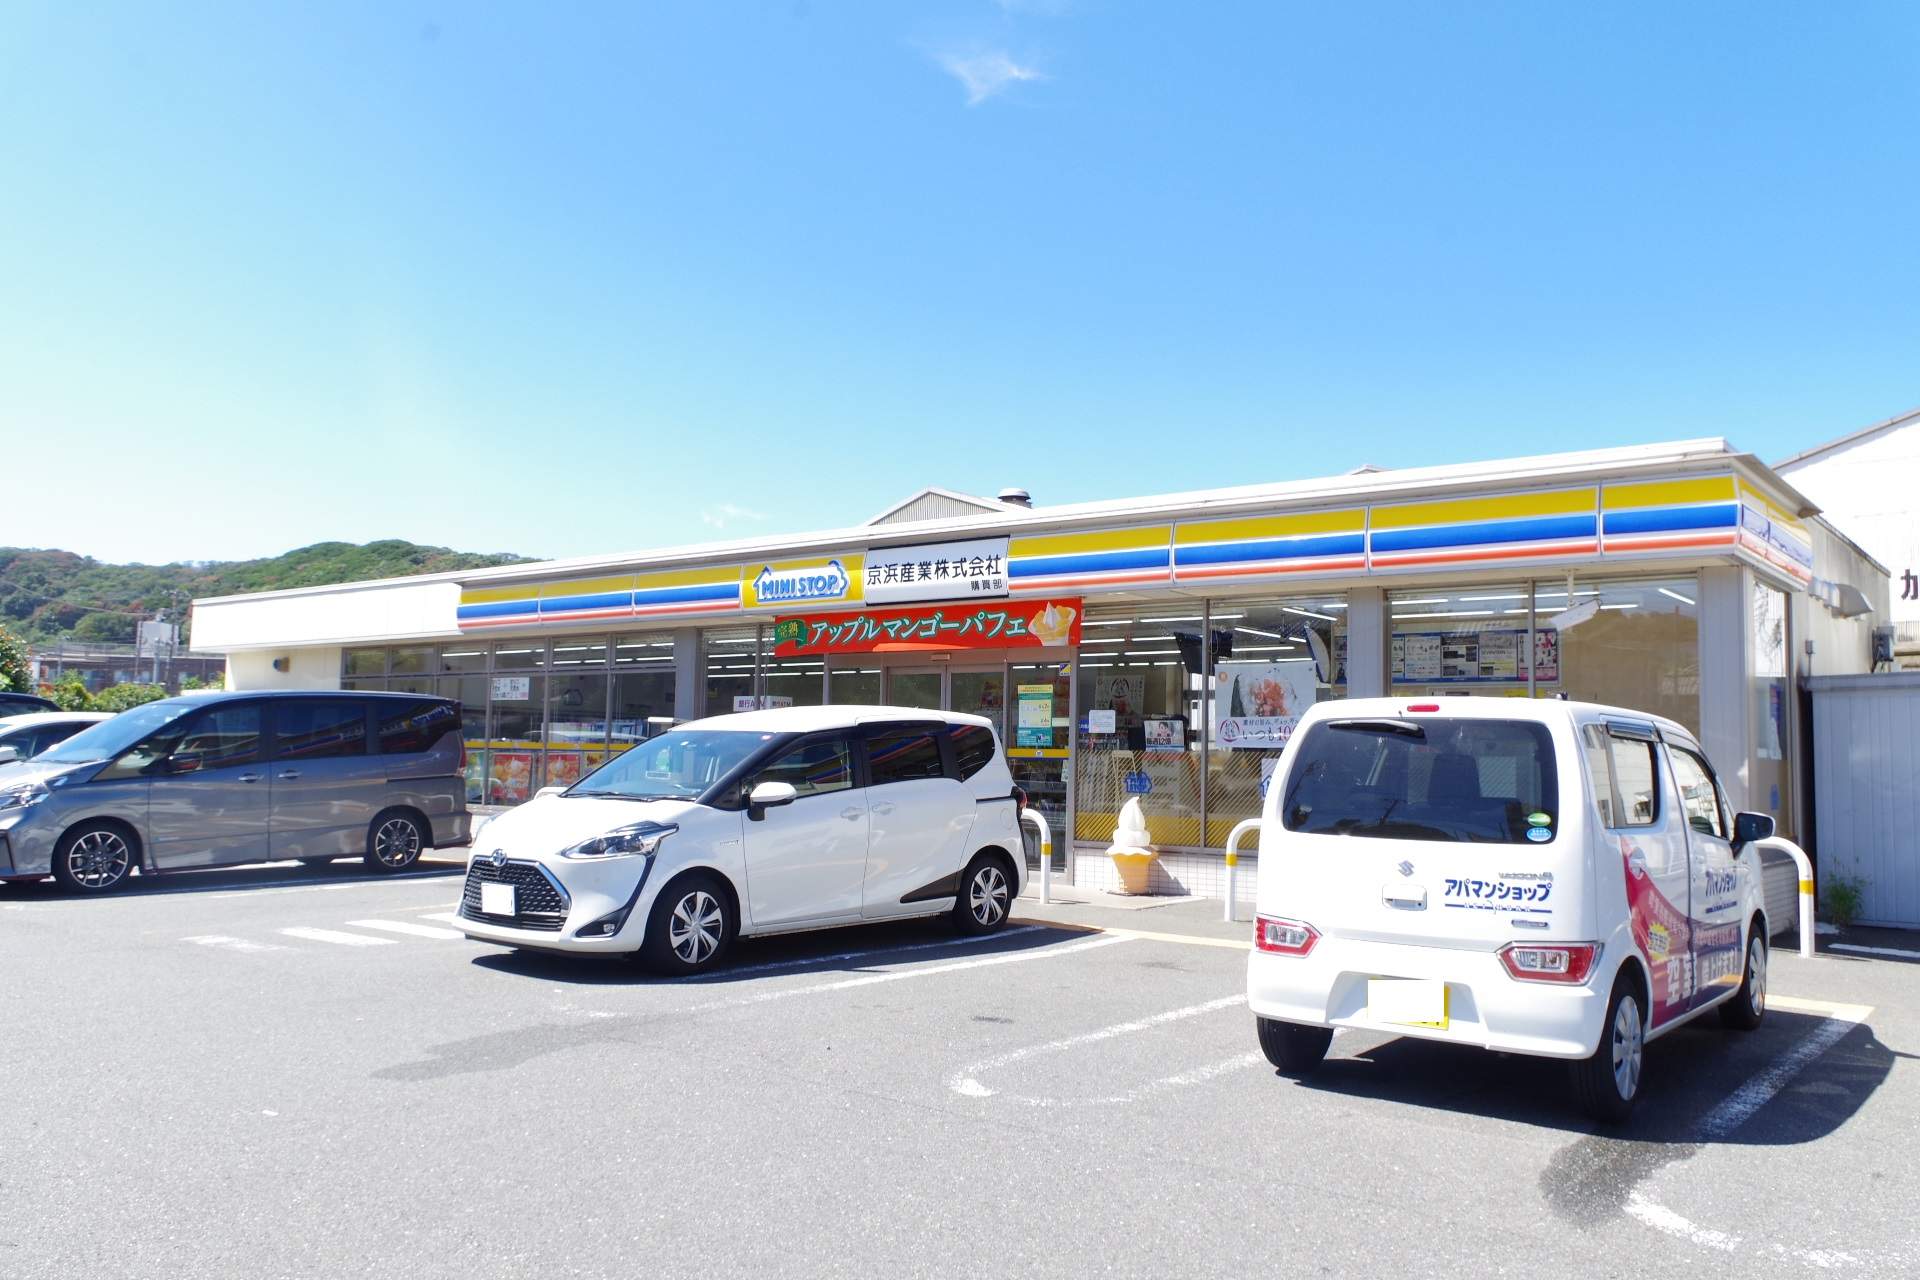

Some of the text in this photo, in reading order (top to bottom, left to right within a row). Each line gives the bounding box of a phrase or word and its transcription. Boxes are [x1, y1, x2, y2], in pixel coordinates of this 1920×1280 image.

[867, 554, 1002, 586] 京浜産業株式会社
[811, 612, 1027, 645] アップルマンゴーパフェ
[1444, 878, 1553, 902] アパマンショップ
